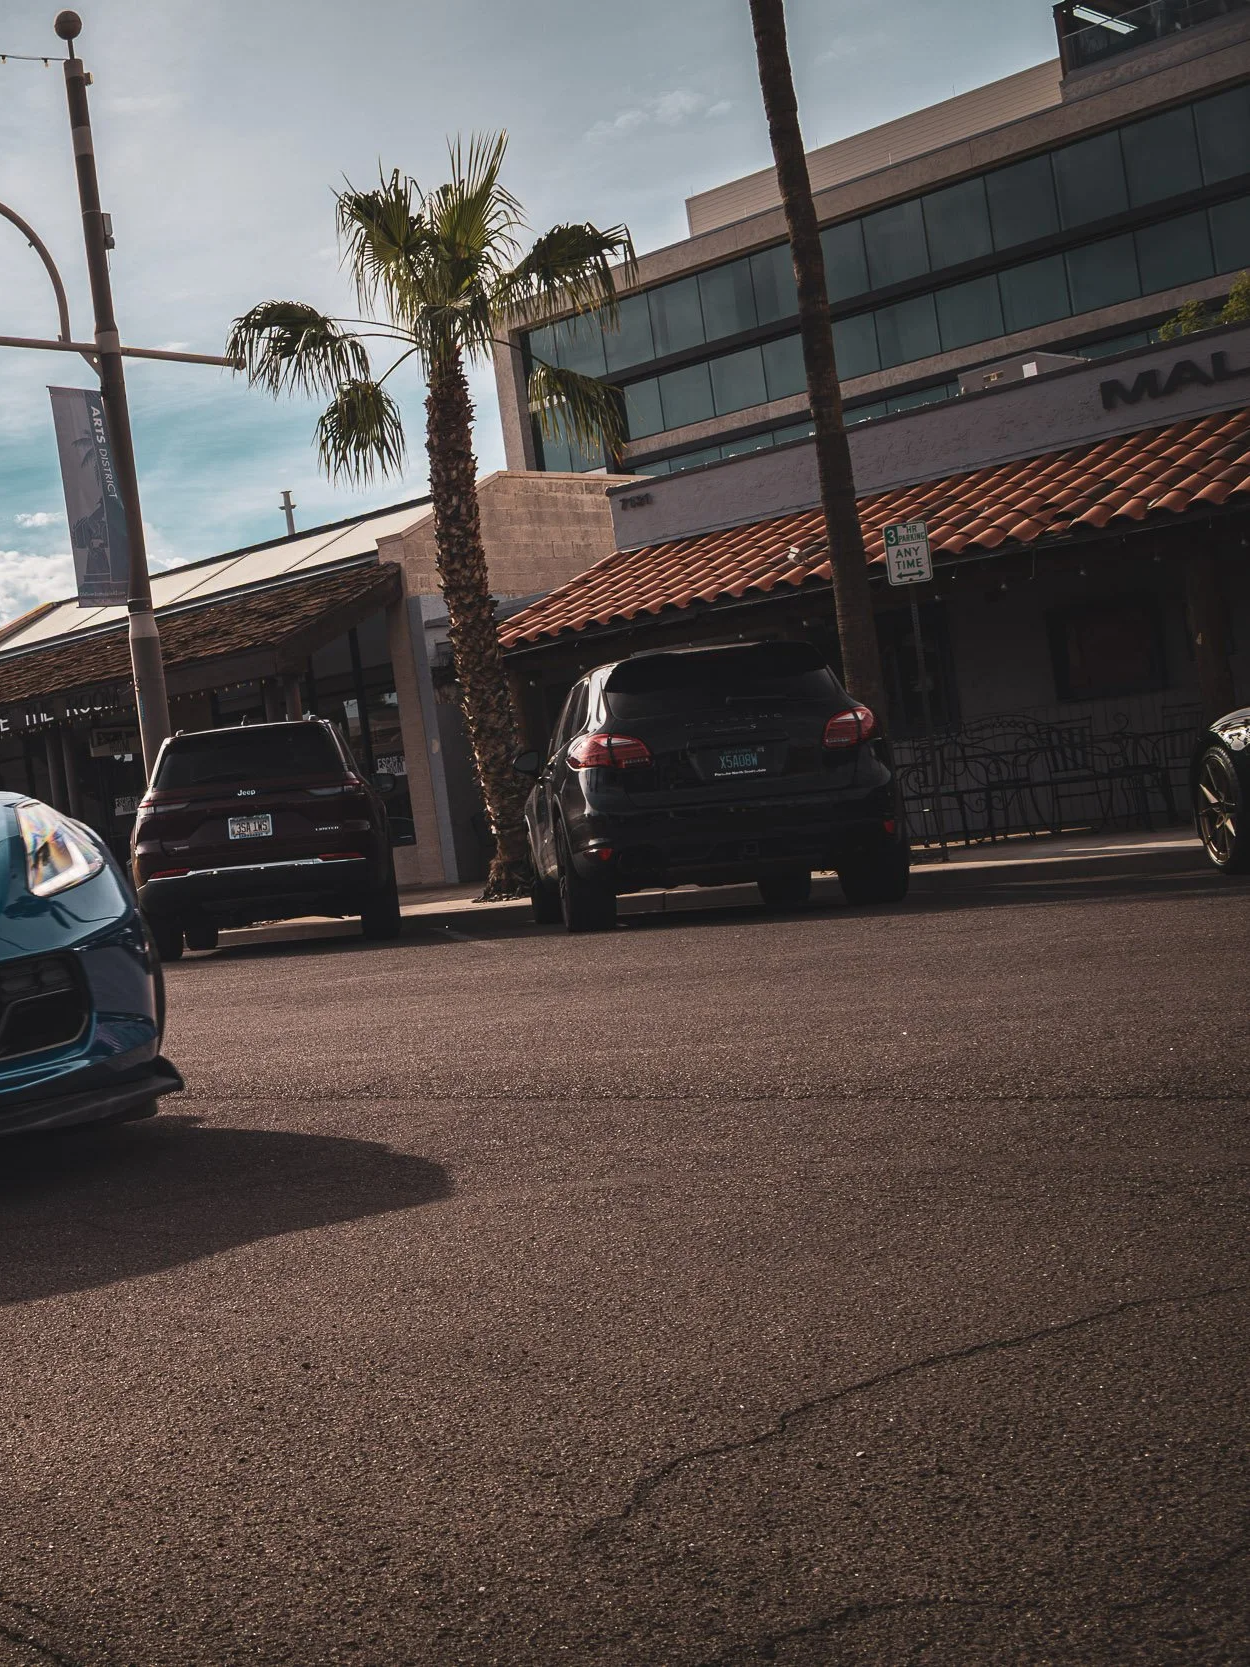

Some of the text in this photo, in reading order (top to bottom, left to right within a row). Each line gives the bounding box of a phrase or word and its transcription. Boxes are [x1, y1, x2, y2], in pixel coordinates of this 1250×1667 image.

[90, 404, 118, 499] ARTS DISTRICT
[886, 525, 918, 545] 3 HR
[898, 532, 925, 543] PARKING
[895, 546, 920, 559] ANY
[895, 558, 923, 570] TIME
